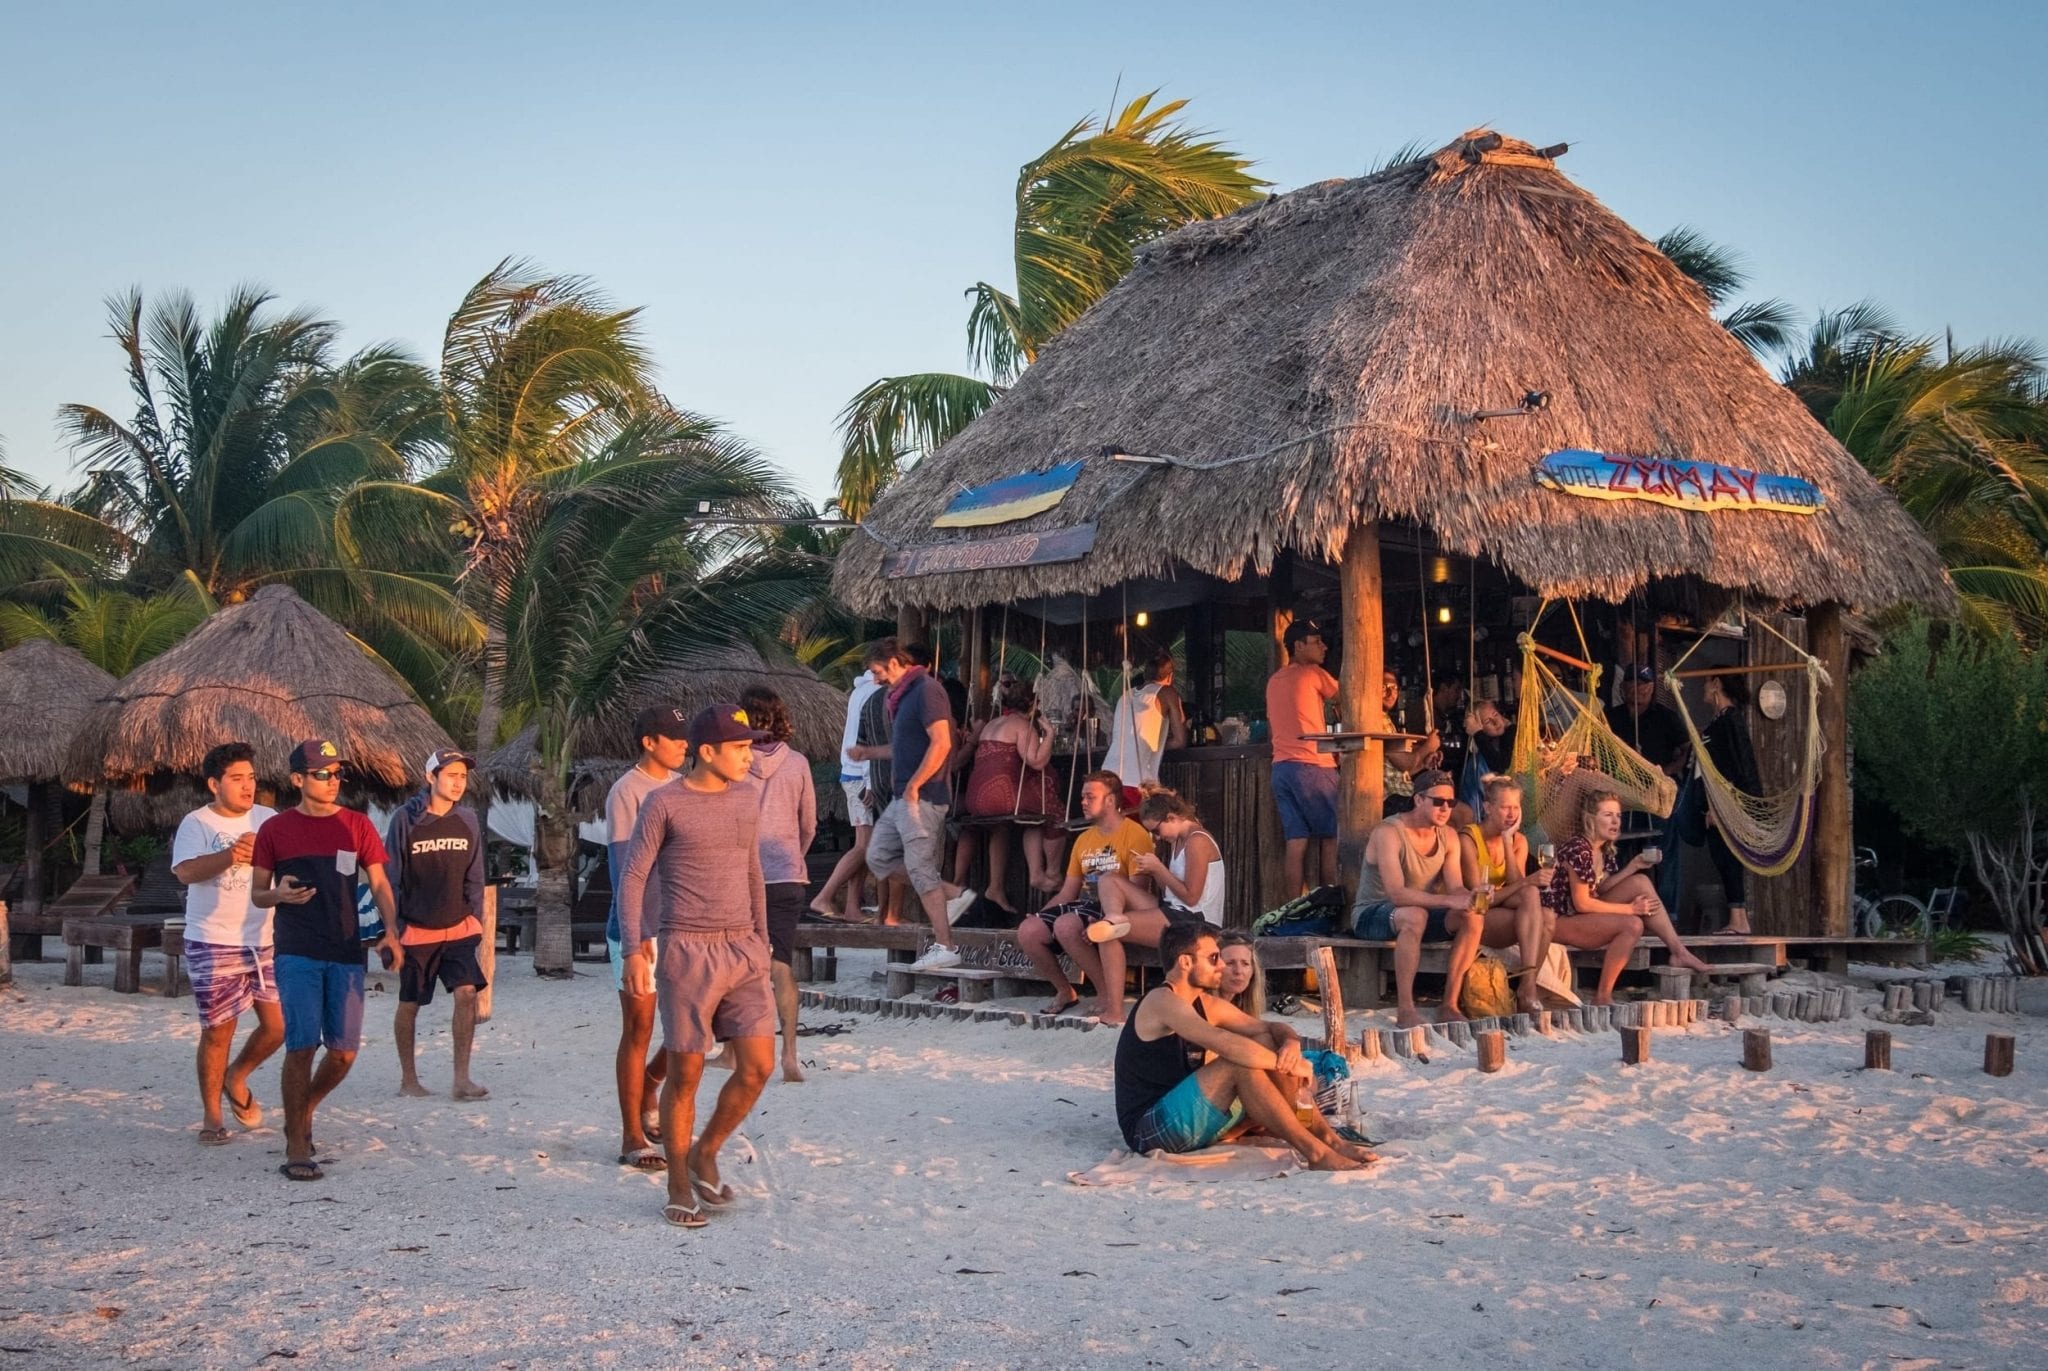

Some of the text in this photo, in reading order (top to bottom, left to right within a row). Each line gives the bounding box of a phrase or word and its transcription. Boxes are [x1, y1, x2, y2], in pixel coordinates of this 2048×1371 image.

[1548, 463, 1606, 489] HOTEL
[1764, 483, 1819, 507] HOLBOX
[411, 838, 469, 854] STARTER
